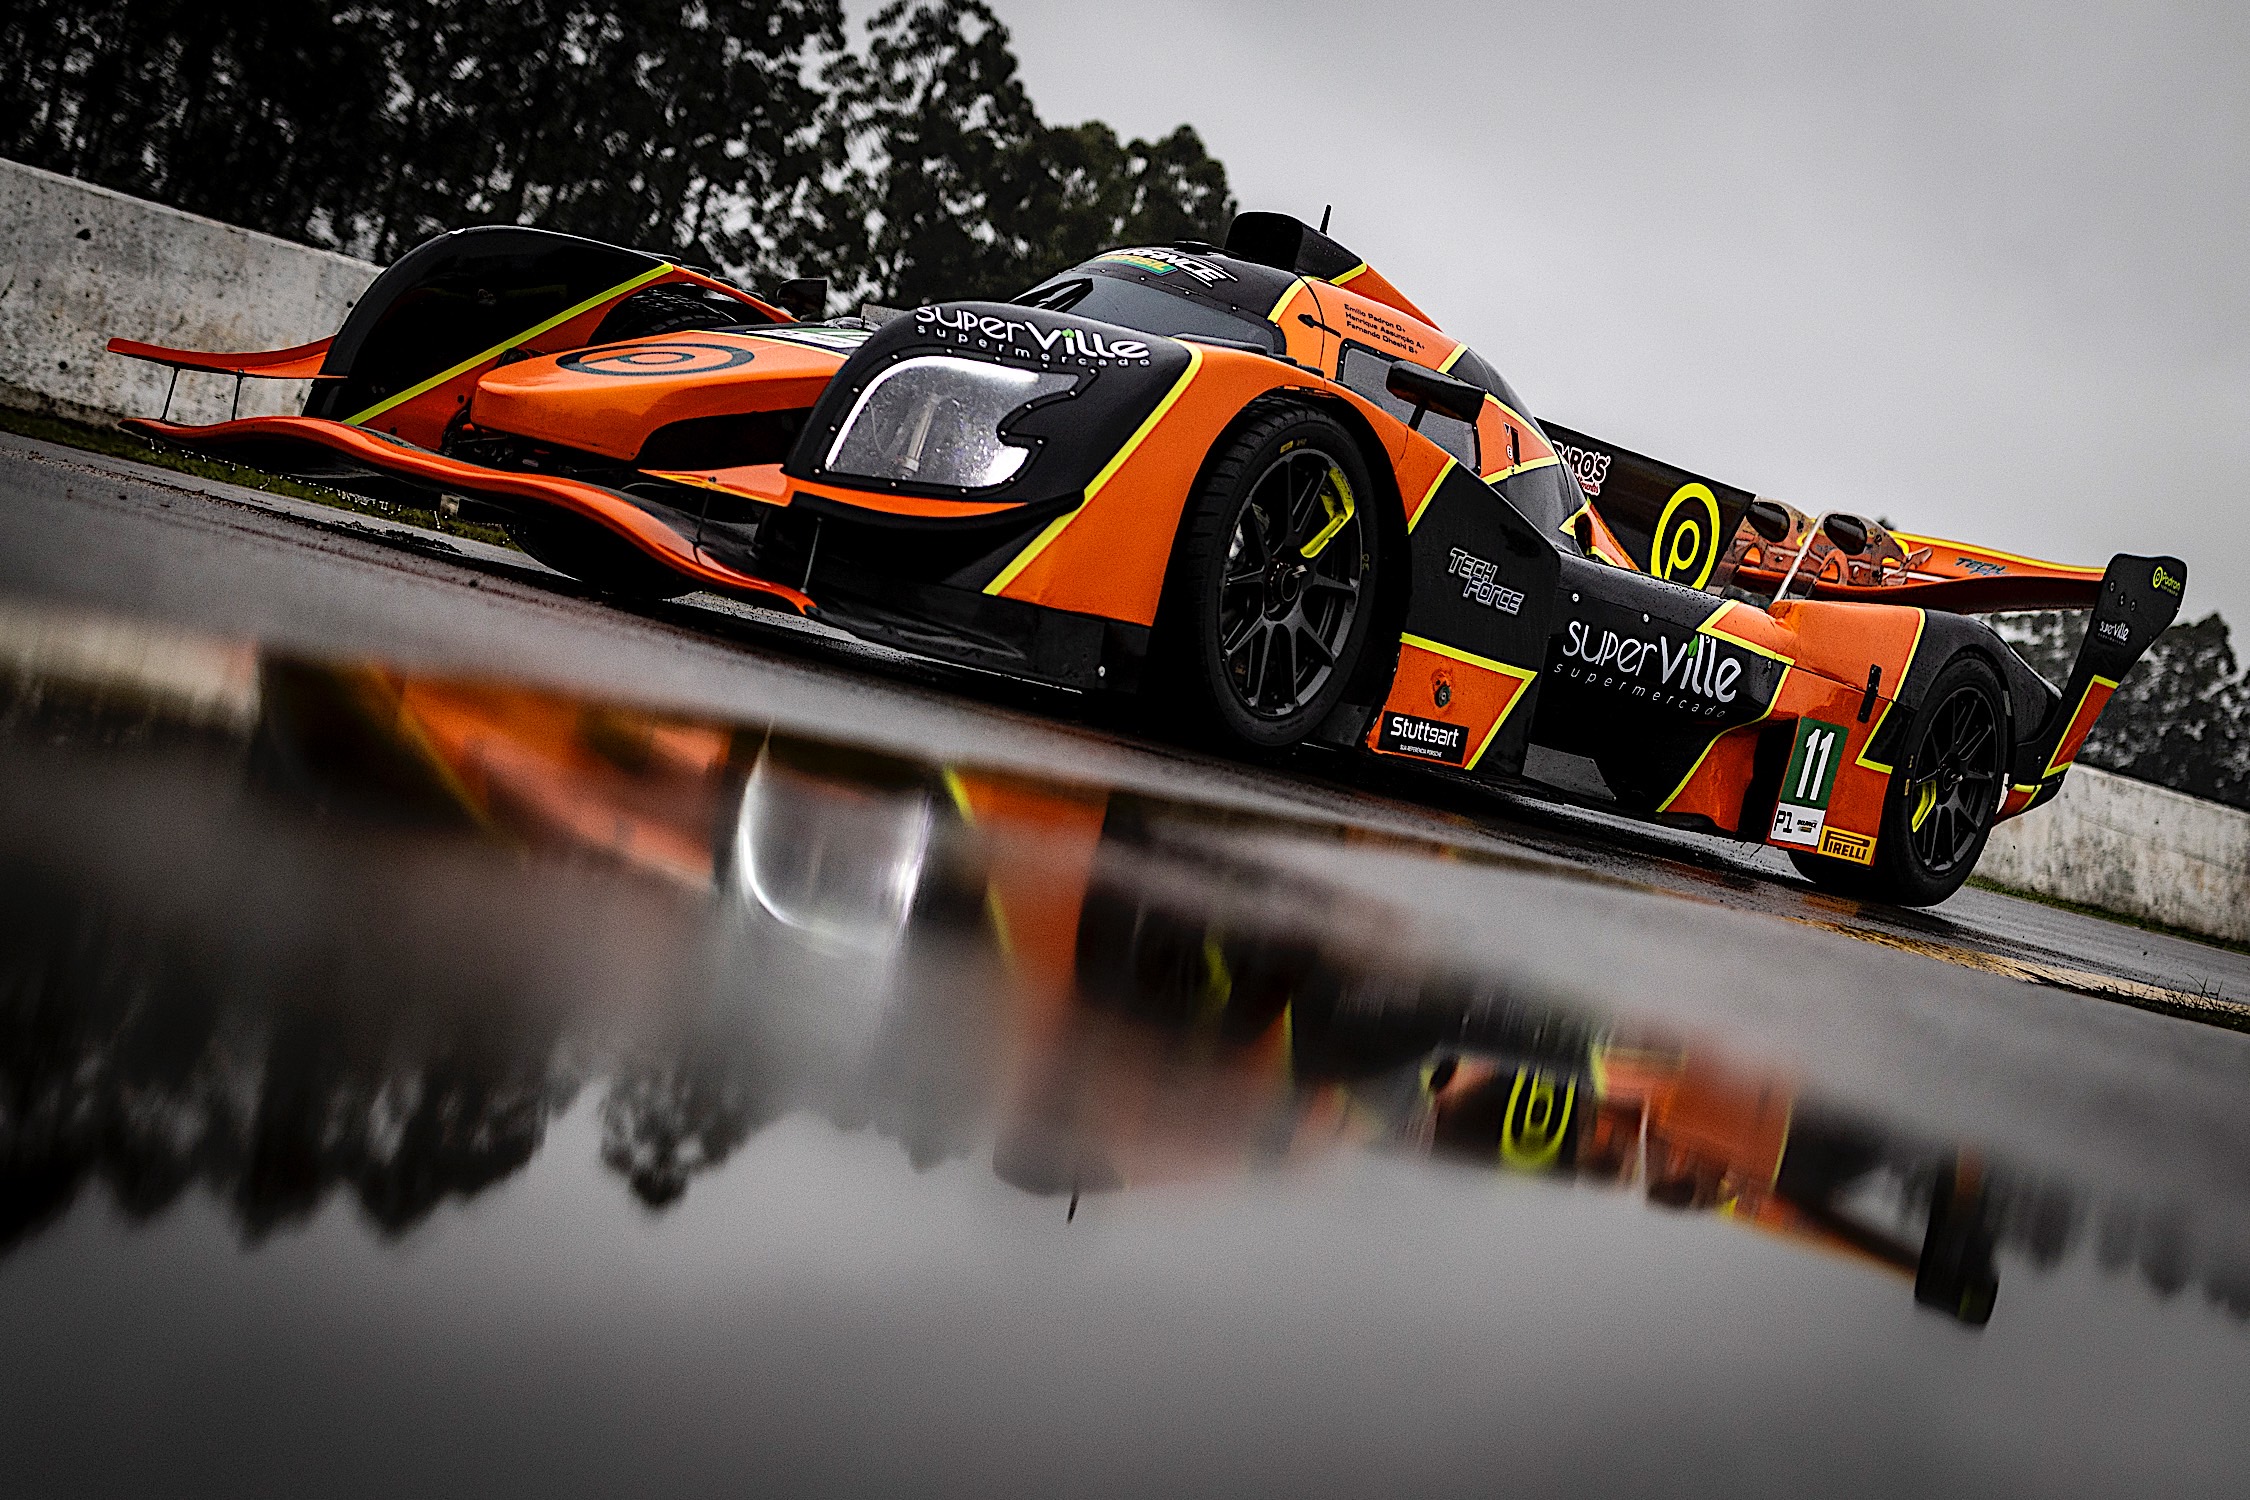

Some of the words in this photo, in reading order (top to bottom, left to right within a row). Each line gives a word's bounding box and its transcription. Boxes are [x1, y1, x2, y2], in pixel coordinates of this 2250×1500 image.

[1345, 311, 1378, 330] Henrique
[1346, 320, 1381, 340] Fernando
[1367, 313, 1394, 329] Padron
[917, 324, 1150, 367] supermercado
[1448, 547, 1498, 583] TECH
[1553, 663, 1726, 718] supermercado
[1390, 716, 1459, 747] Stuttgart
[1796, 728, 1836, 801] 11
[1773, 809, 1793, 834] P1
[1822, 829, 1871, 861] PIRELLI
